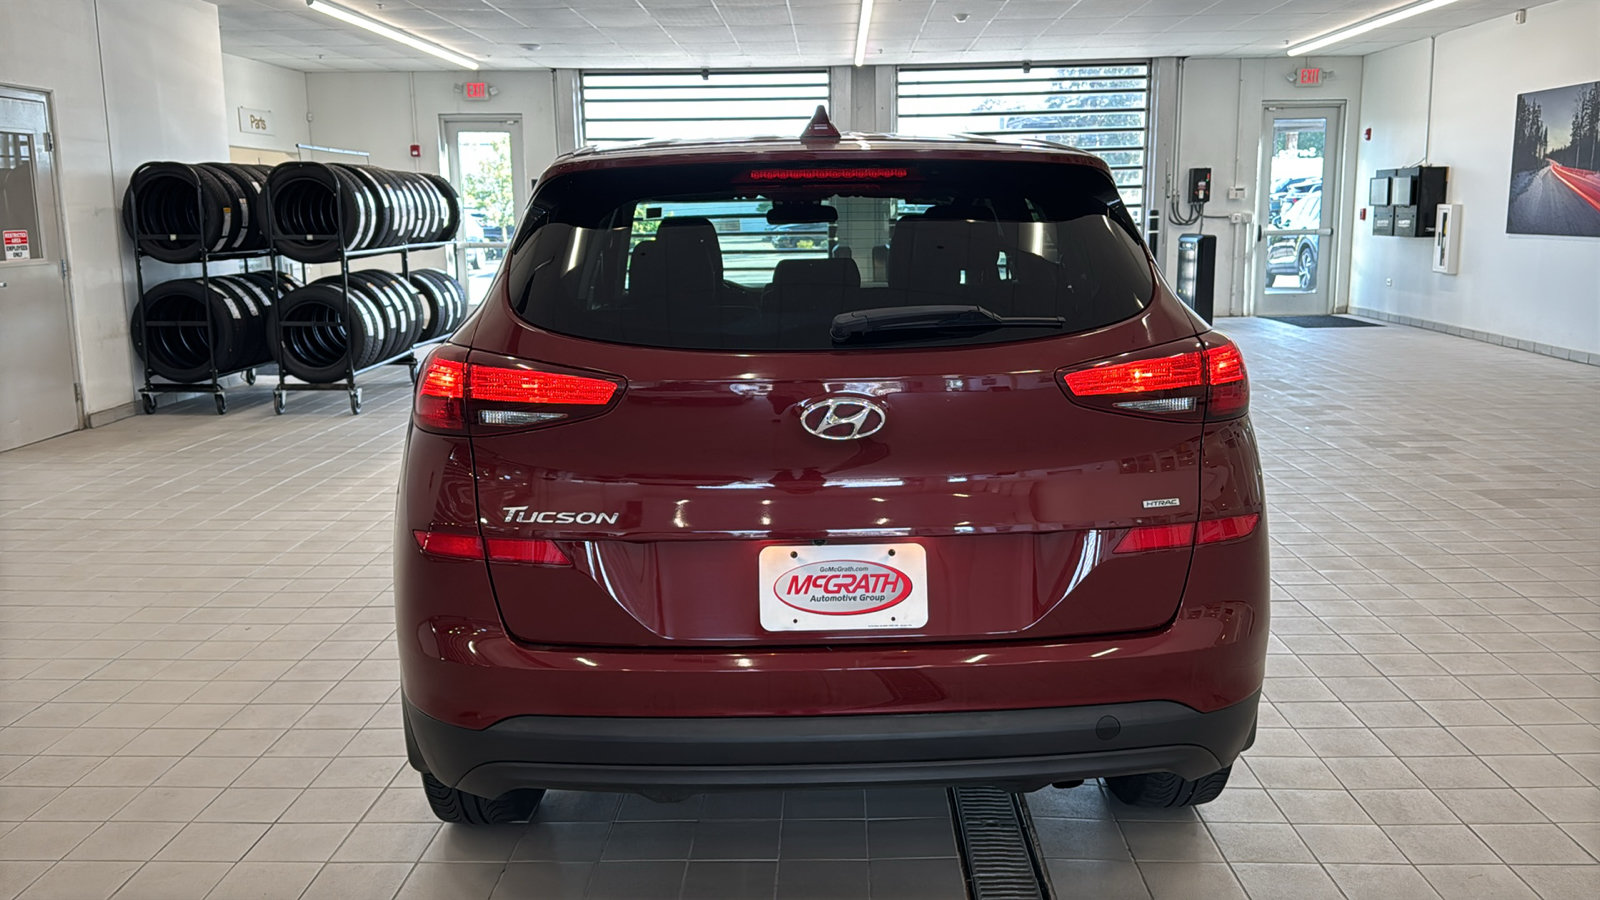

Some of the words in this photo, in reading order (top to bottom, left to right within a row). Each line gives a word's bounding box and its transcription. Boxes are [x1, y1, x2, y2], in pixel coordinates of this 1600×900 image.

[1301, 68, 1320, 84] EXIT
[467, 82, 485, 97] EXIT
[1146, 499, 1178, 507] HTRAC
[819, 565, 869, 573] GoMcGrath.com
[810, 594, 858, 602] Automotive
[859, 593, 886, 602] Group
